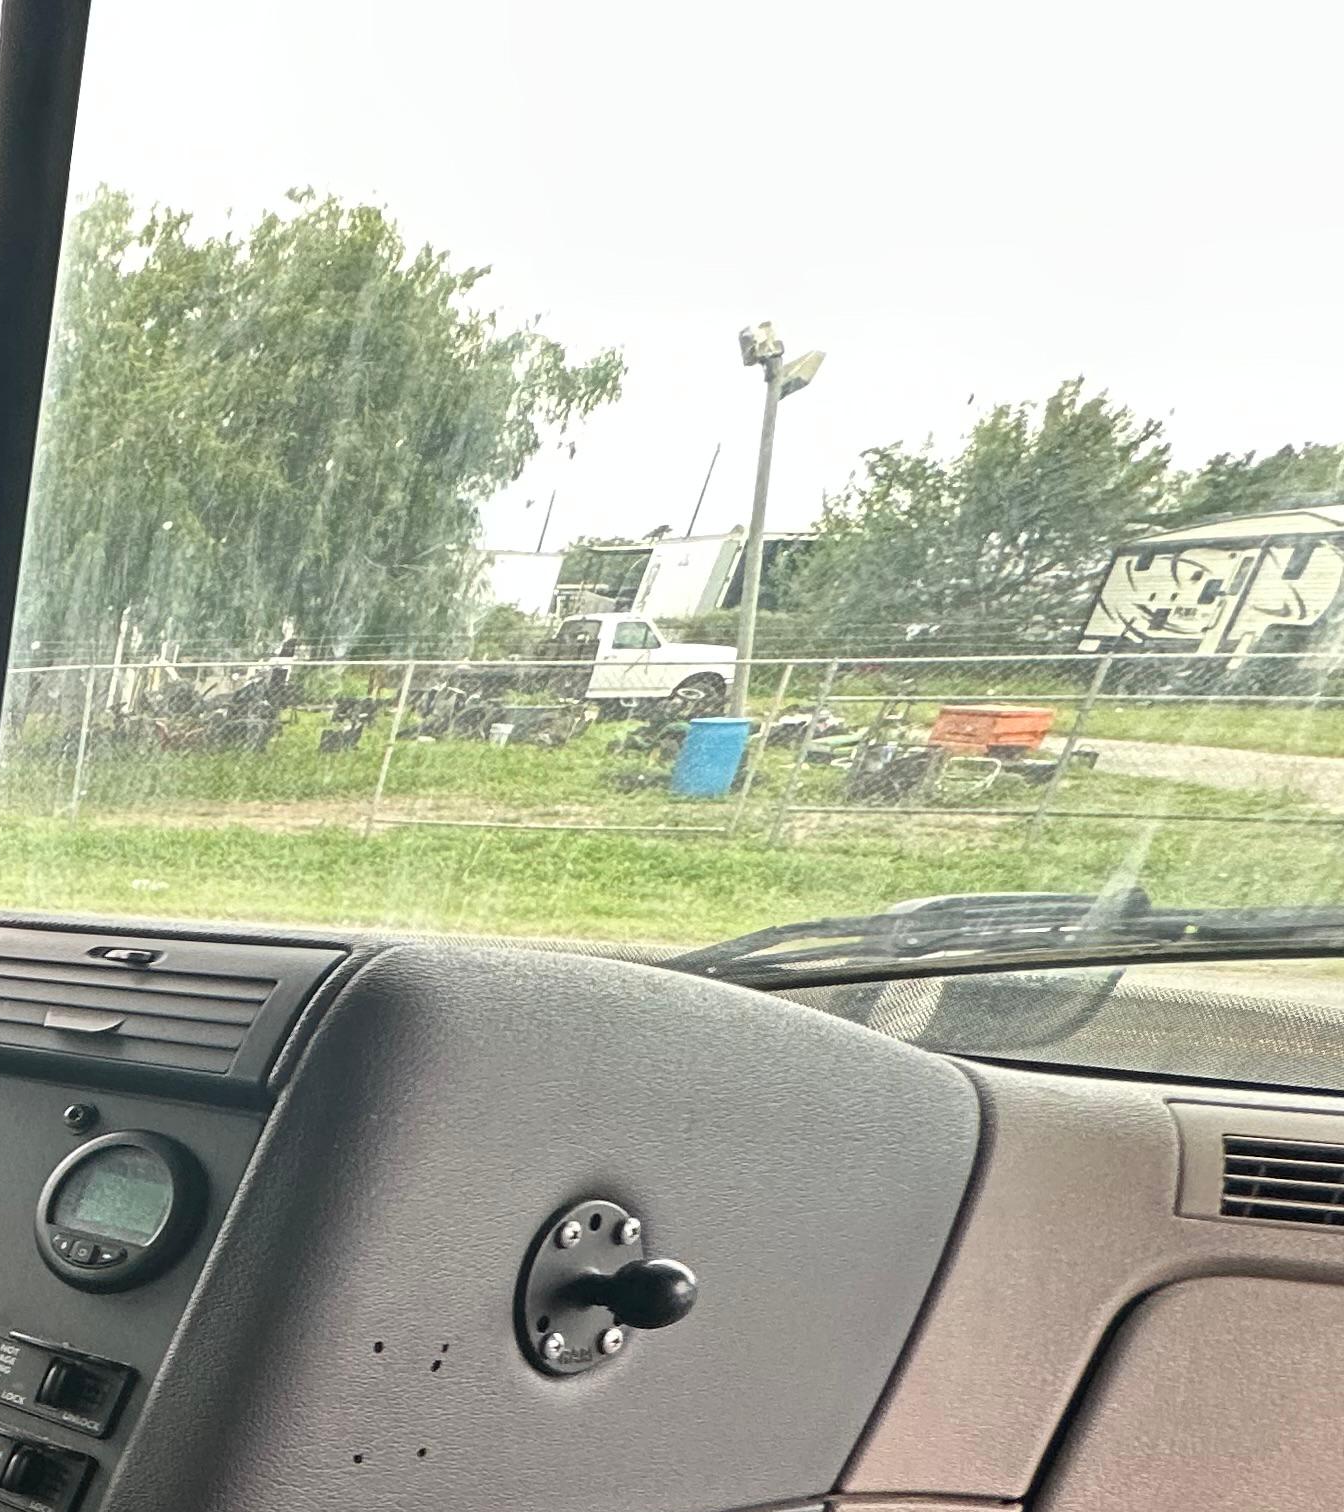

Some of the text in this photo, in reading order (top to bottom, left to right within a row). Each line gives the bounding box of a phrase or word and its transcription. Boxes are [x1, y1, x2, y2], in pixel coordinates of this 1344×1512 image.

[0, 1344, 20, 1356] NOT
[1, 1390, 26, 1405] LOCK
[62, 1411, 100, 1431] UNLOCK
